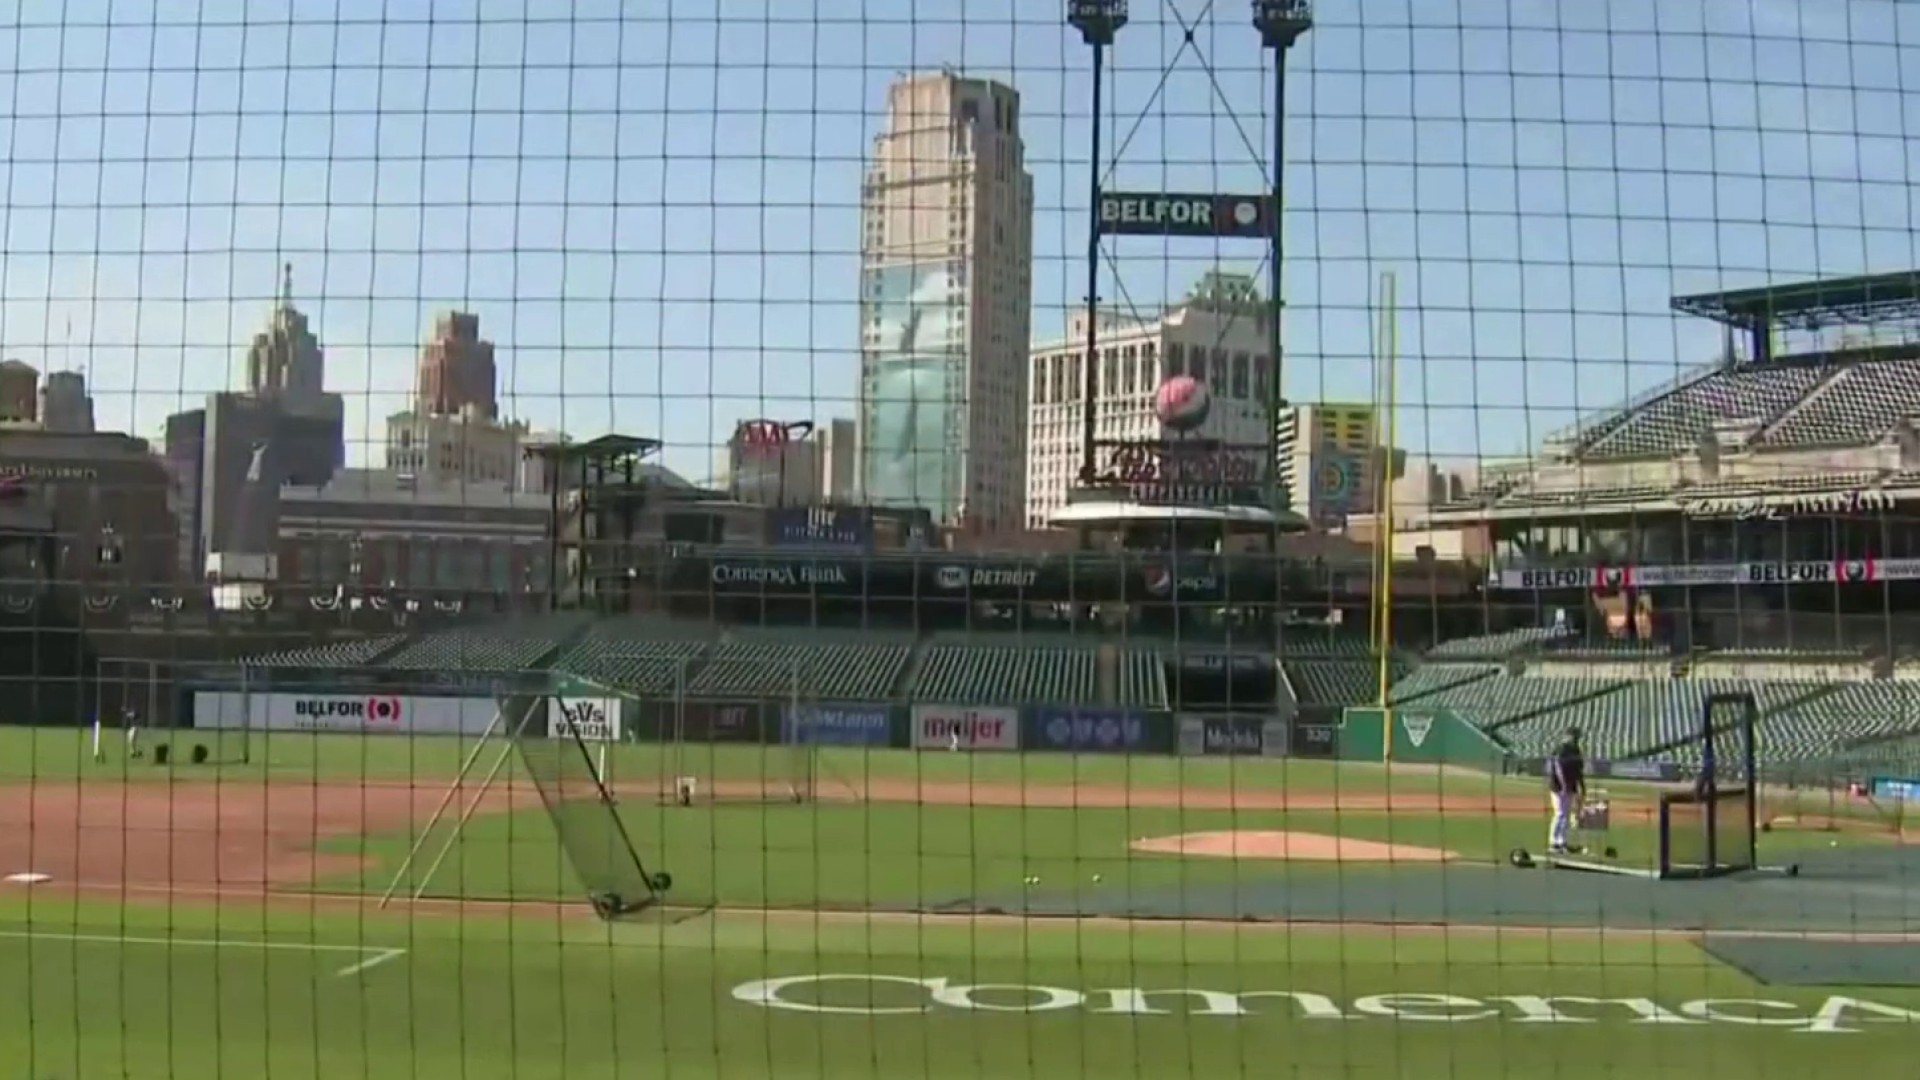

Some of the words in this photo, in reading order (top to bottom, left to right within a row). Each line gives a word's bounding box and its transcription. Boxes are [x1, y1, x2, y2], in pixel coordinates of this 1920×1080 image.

[1101, 200, 1212, 224] BELFOR
[801, 566, 846, 583] Bank
[973, 568, 1037, 586] DETROIT
[1522, 571, 1592, 587] BELFOR
[1749, 562, 1831, 581] BELFOR
[296, 701, 363, 716] BELFOR
[924, 711, 1002, 744] meijer
